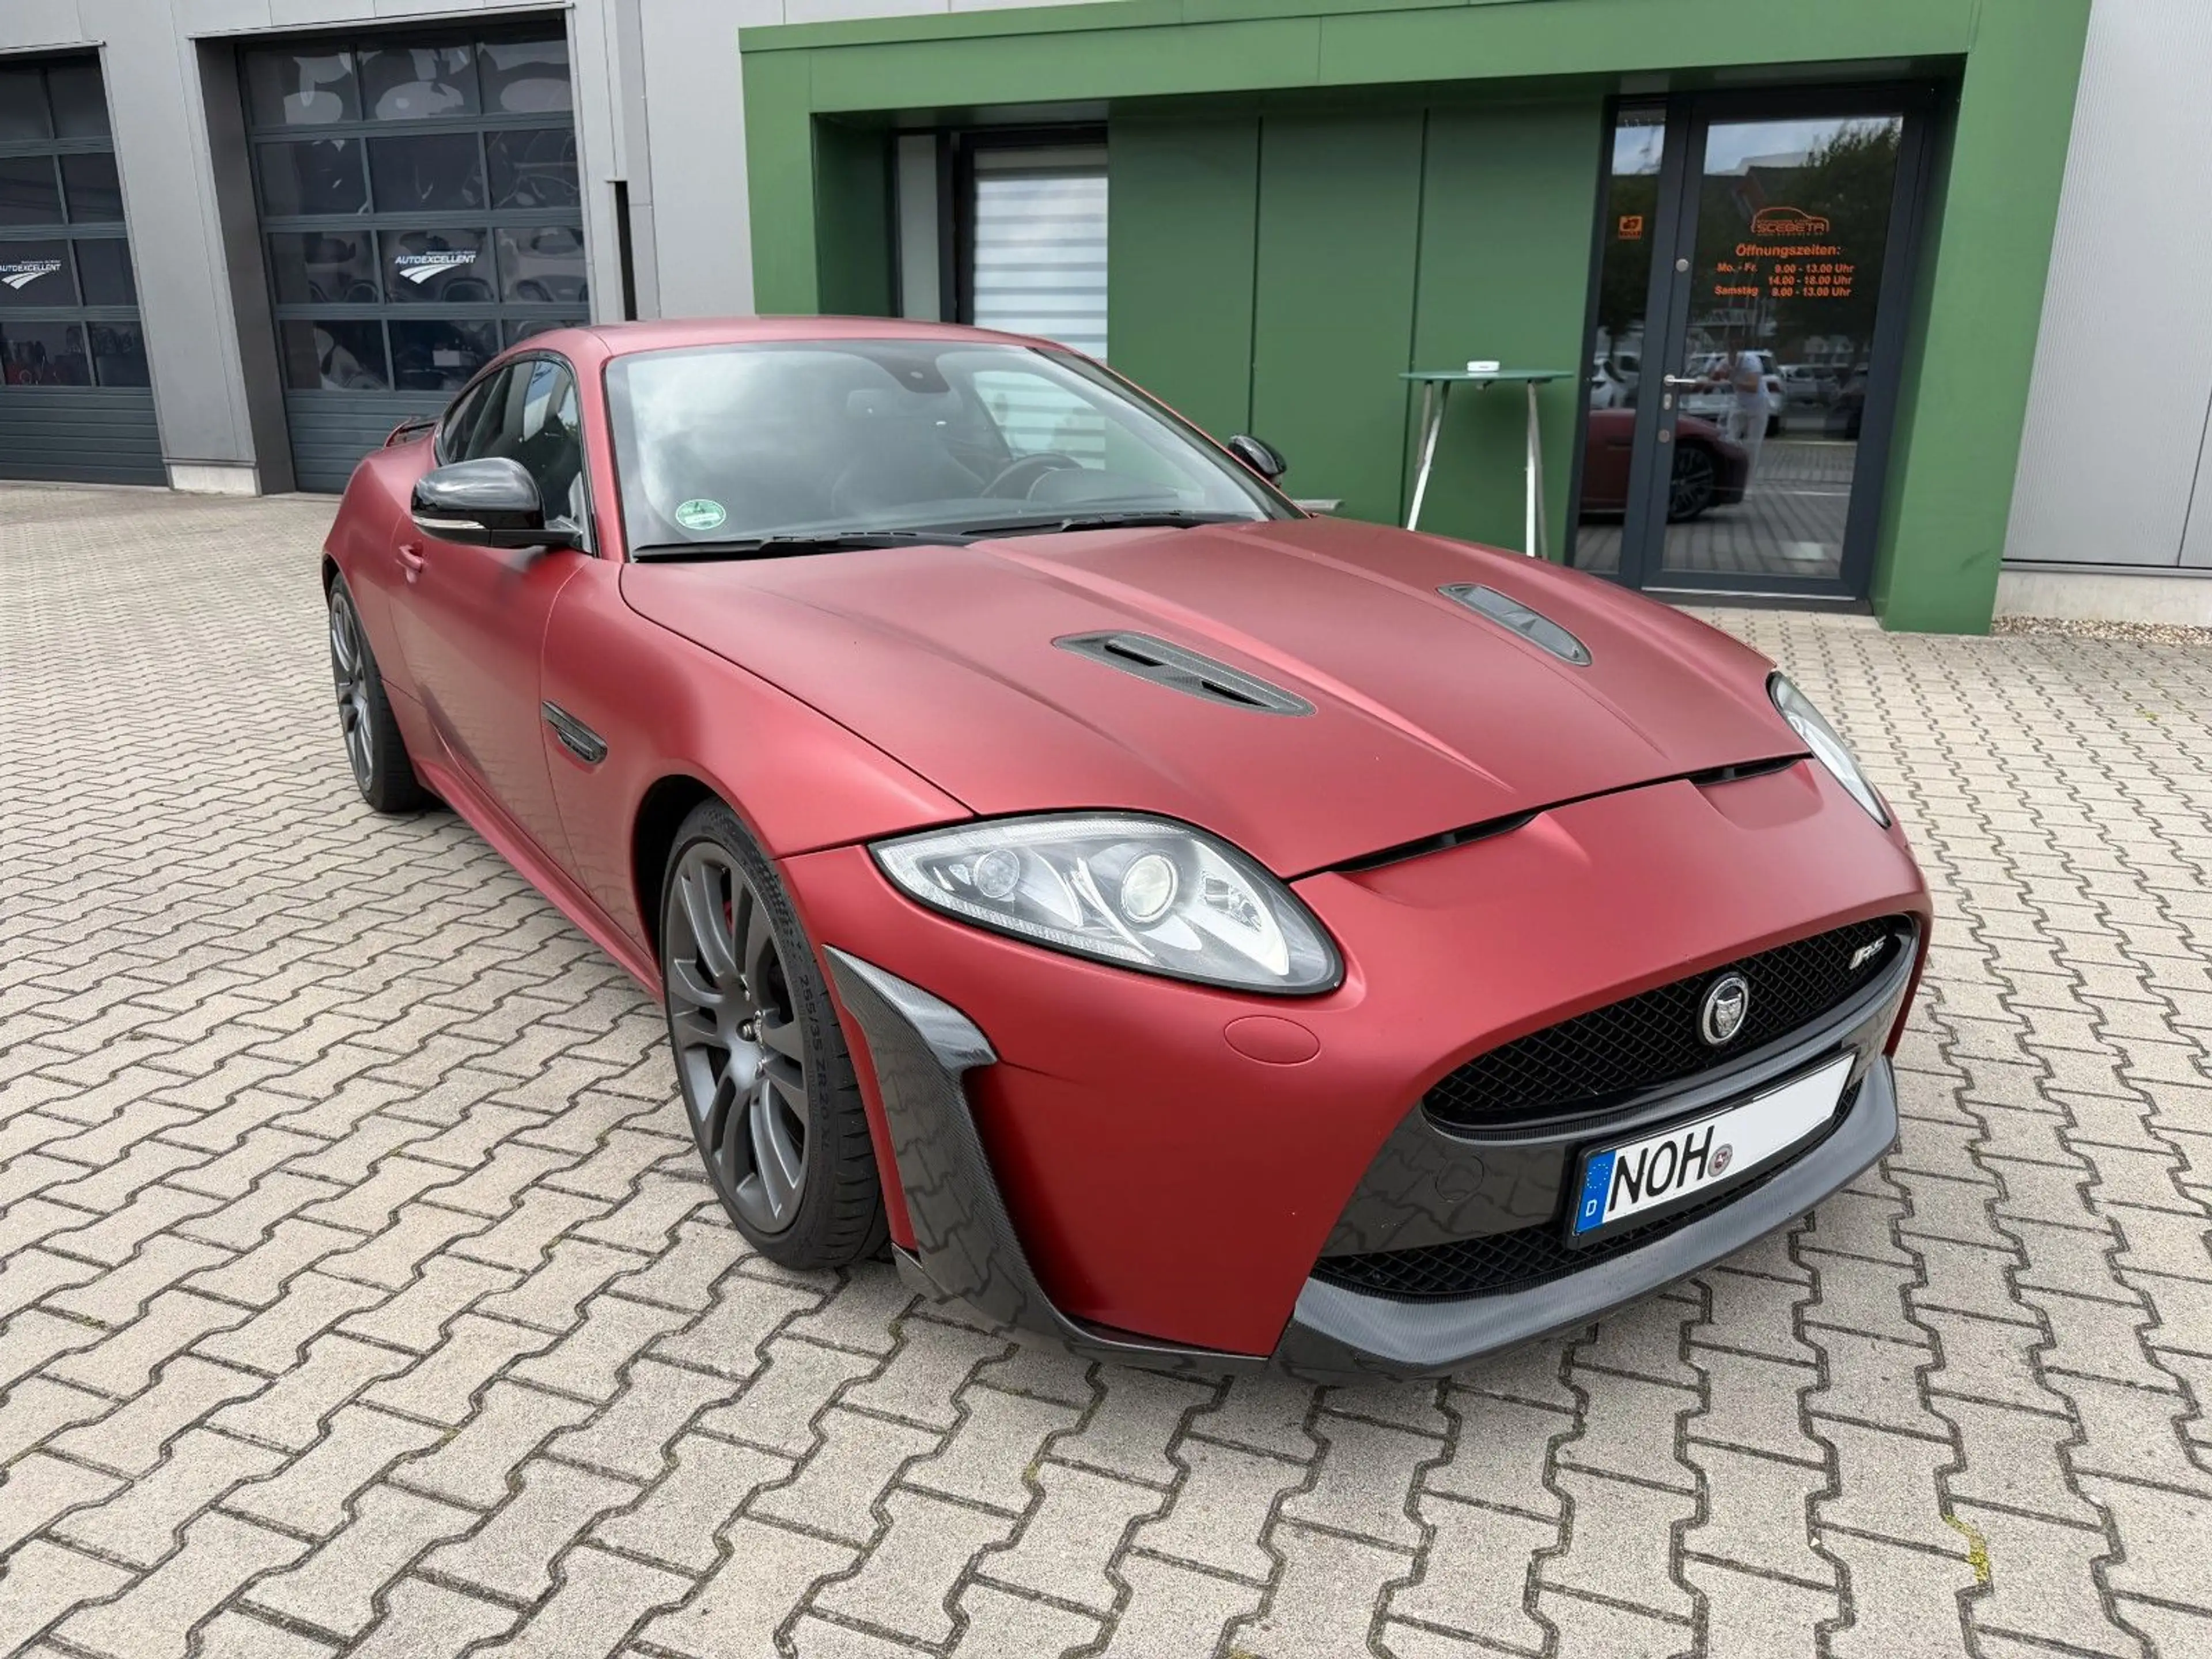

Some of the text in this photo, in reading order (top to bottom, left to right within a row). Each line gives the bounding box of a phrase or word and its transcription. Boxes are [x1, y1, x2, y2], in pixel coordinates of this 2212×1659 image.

[1736, 243, 1842, 258] Öffnungszeiten:
[395, 255, 476, 264] AUTOEXCELLENT
[1835, 263, 1855, 273] Uhr
[1833, 275, 1853, 285] Uhr
[1714, 285, 1759, 296] Samstag
[1831, 287, 1851, 297] Uhr
[1608, 1125, 1715, 1211] NOH
[1585, 1199, 1597, 1217] D
